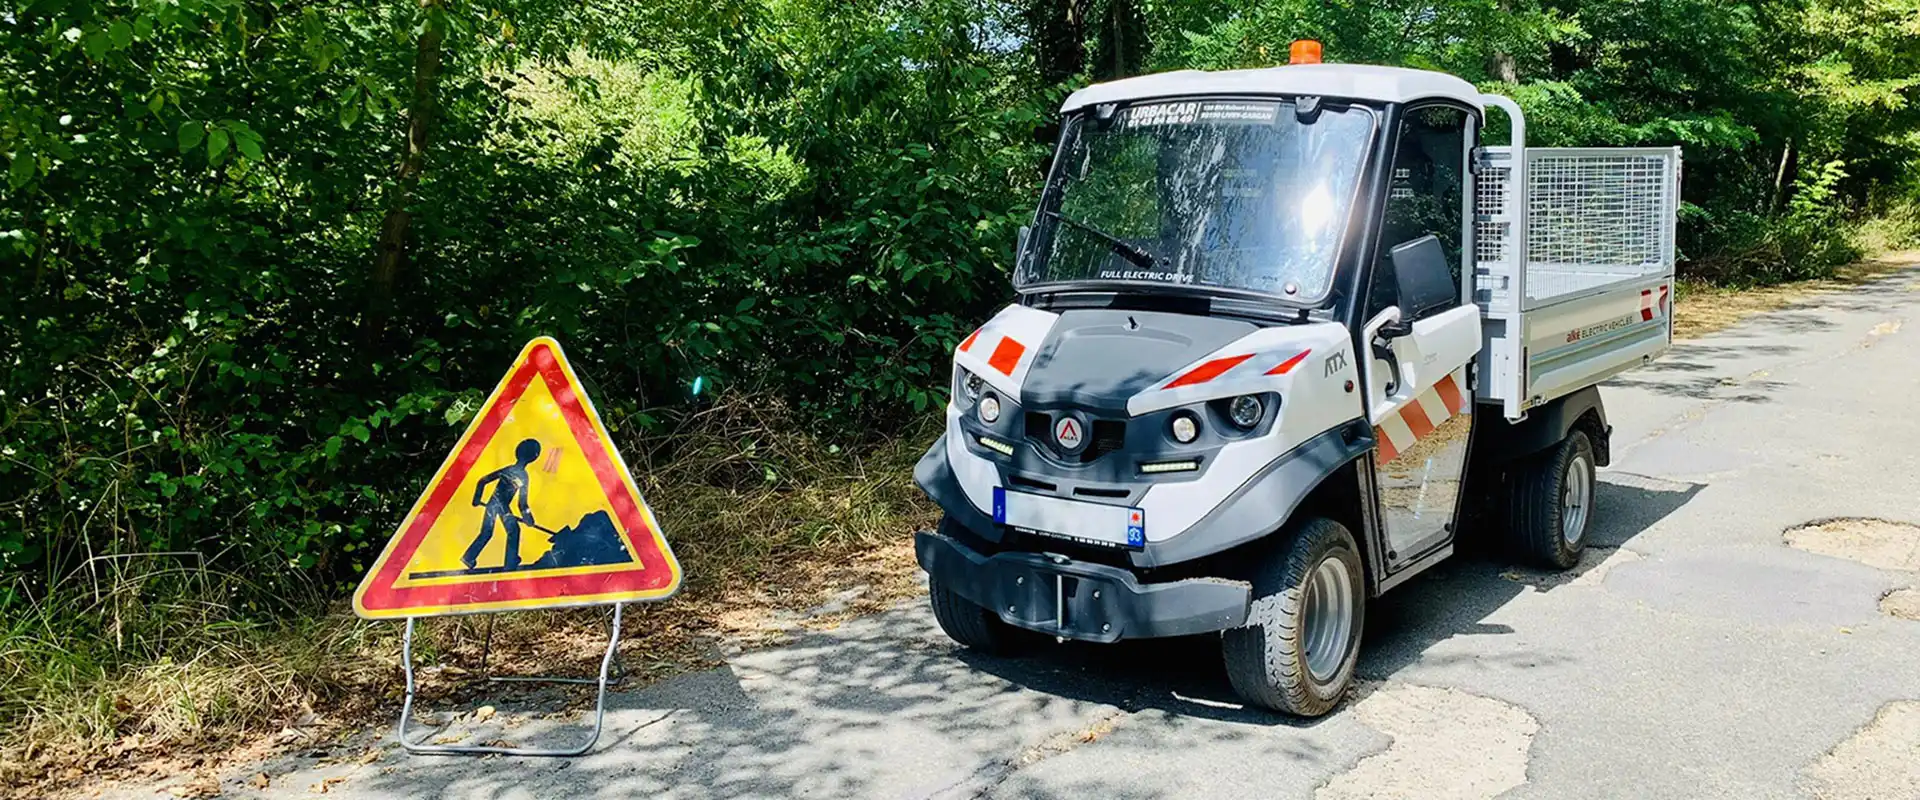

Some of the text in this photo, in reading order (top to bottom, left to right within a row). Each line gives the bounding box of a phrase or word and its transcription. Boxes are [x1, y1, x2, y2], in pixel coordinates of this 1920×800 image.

[1131, 103, 1197, 119] URBACAR
[1100, 270, 1195, 283] FULL ELECTRIC DRIVE
[1582, 324, 1608, 338] ELECTRIC
[1609, 316, 1633, 330] VEHICLES
[1324, 349, 1348, 378] ATX
[1129, 527, 1141, 542] 93
